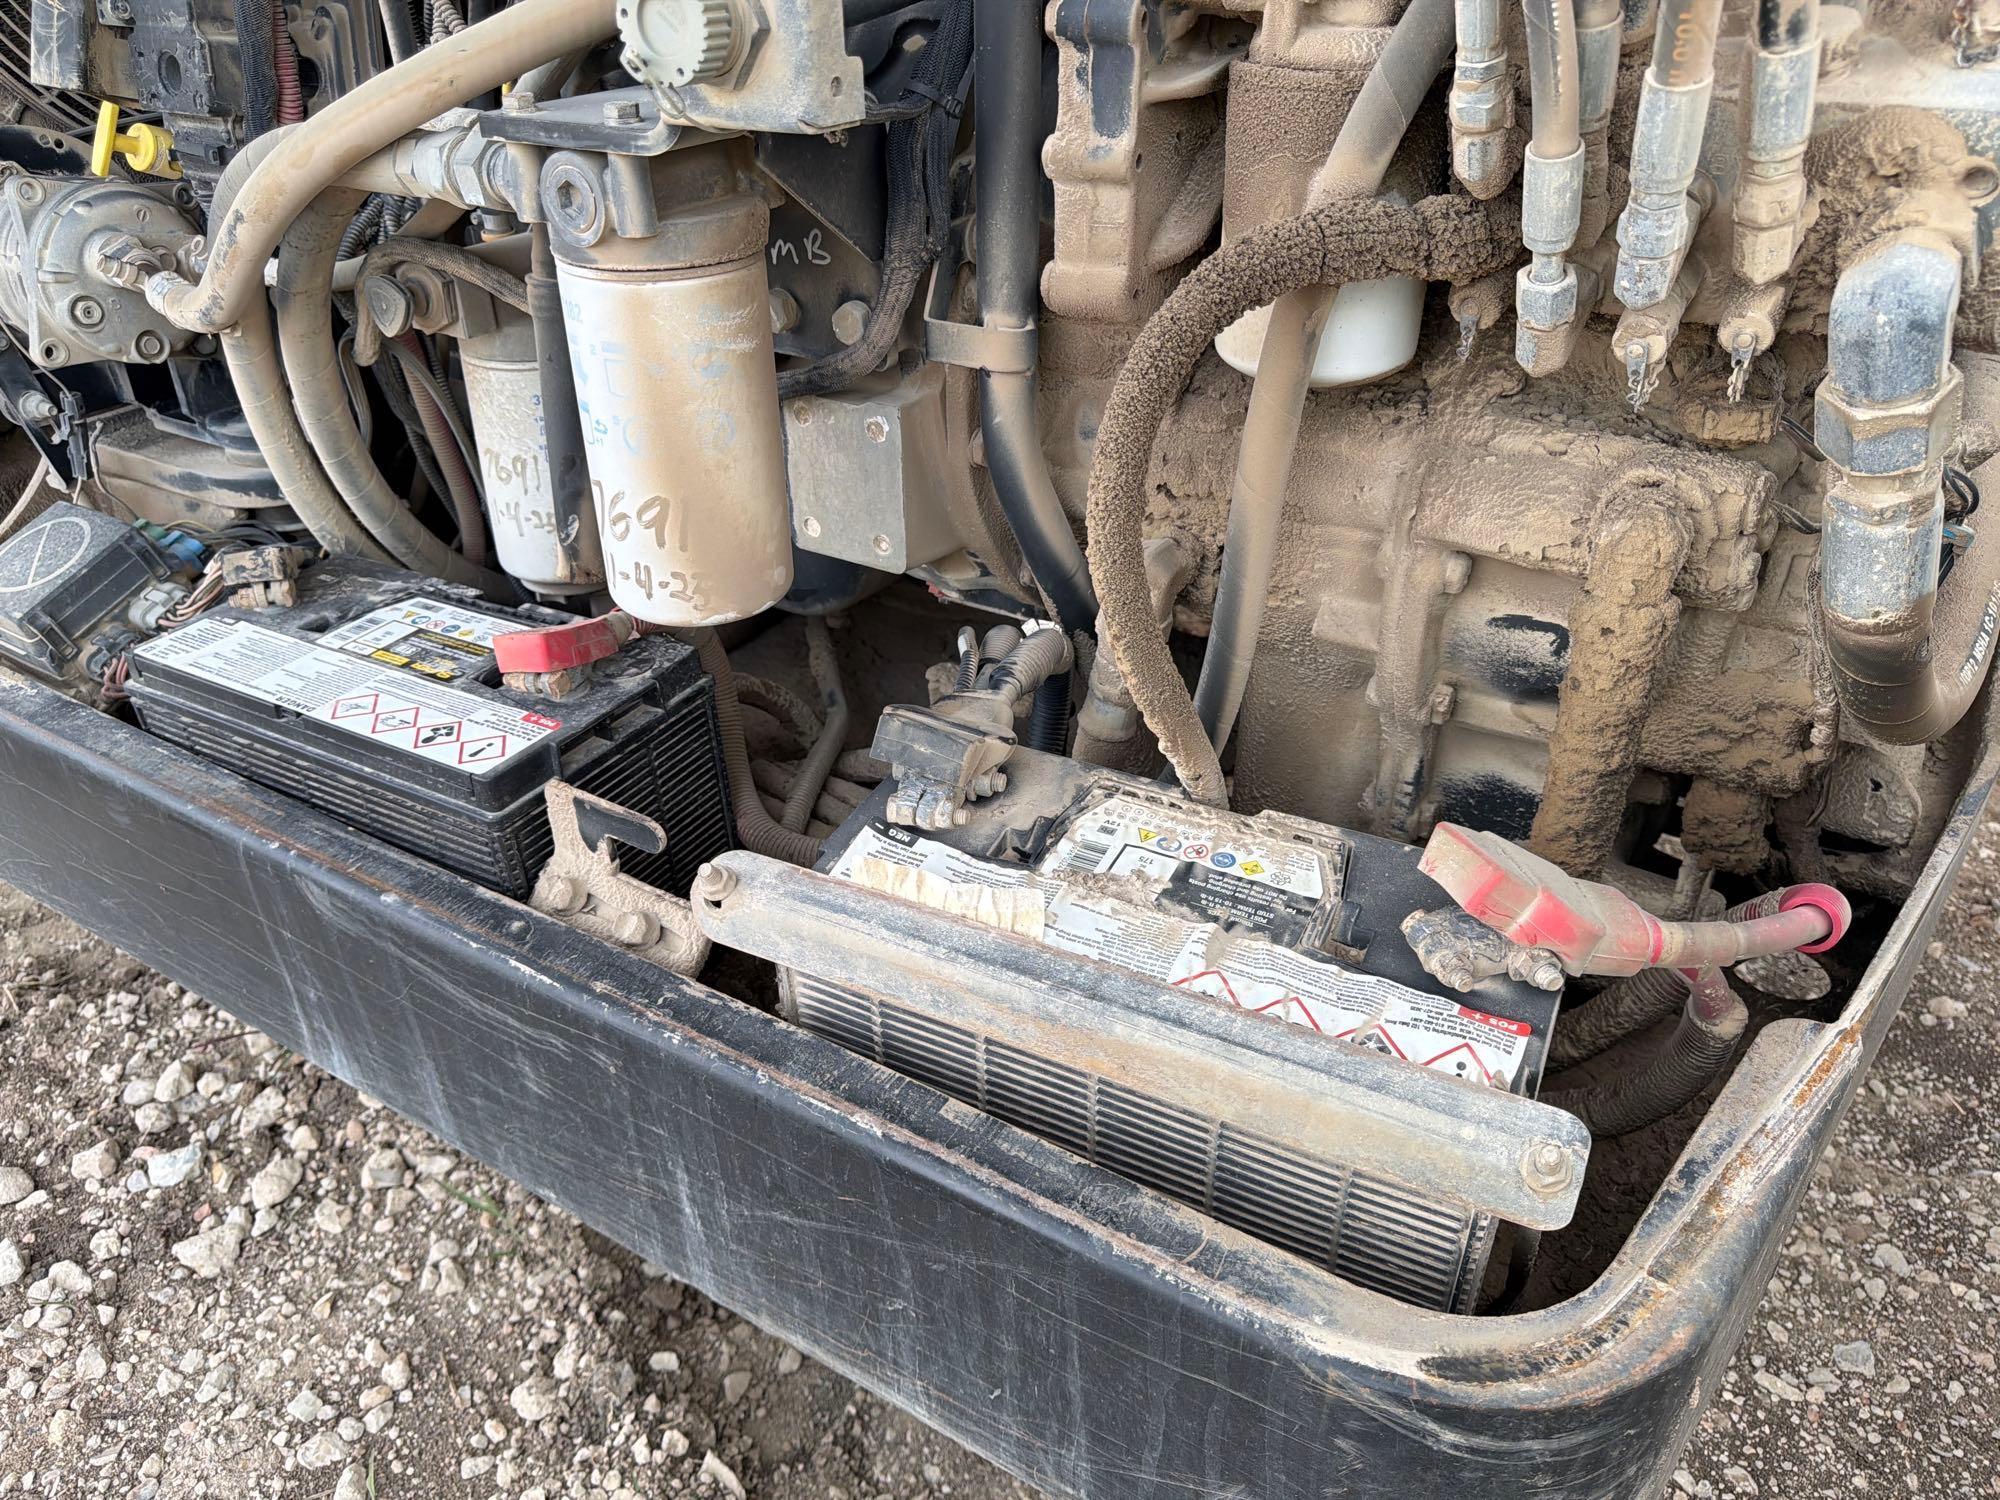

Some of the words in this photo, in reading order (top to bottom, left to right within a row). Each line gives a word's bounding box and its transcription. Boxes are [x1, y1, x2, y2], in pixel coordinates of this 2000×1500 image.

[1972, 631, 1990, 663] MSHA
[1103, 817, 1121, 828] 12V
[887, 827, 911, 842] NEG
[1099, 825, 1114, 834] Pb
[1136, 854, 1154, 866] 175
[1187, 877, 1206, 887] posts
[1205, 883, 1234, 896] charging
[1236, 886, 1249, 894] and
[1213, 897, 1232, 906] 10-15
[1246, 895, 1269, 906] results
[1256, 909, 1275, 919] STUD
[1284, 906, 1296, 914] For
[1250, 914, 1268, 923] POST
[1487, 1016, 1518, 1031] POS
